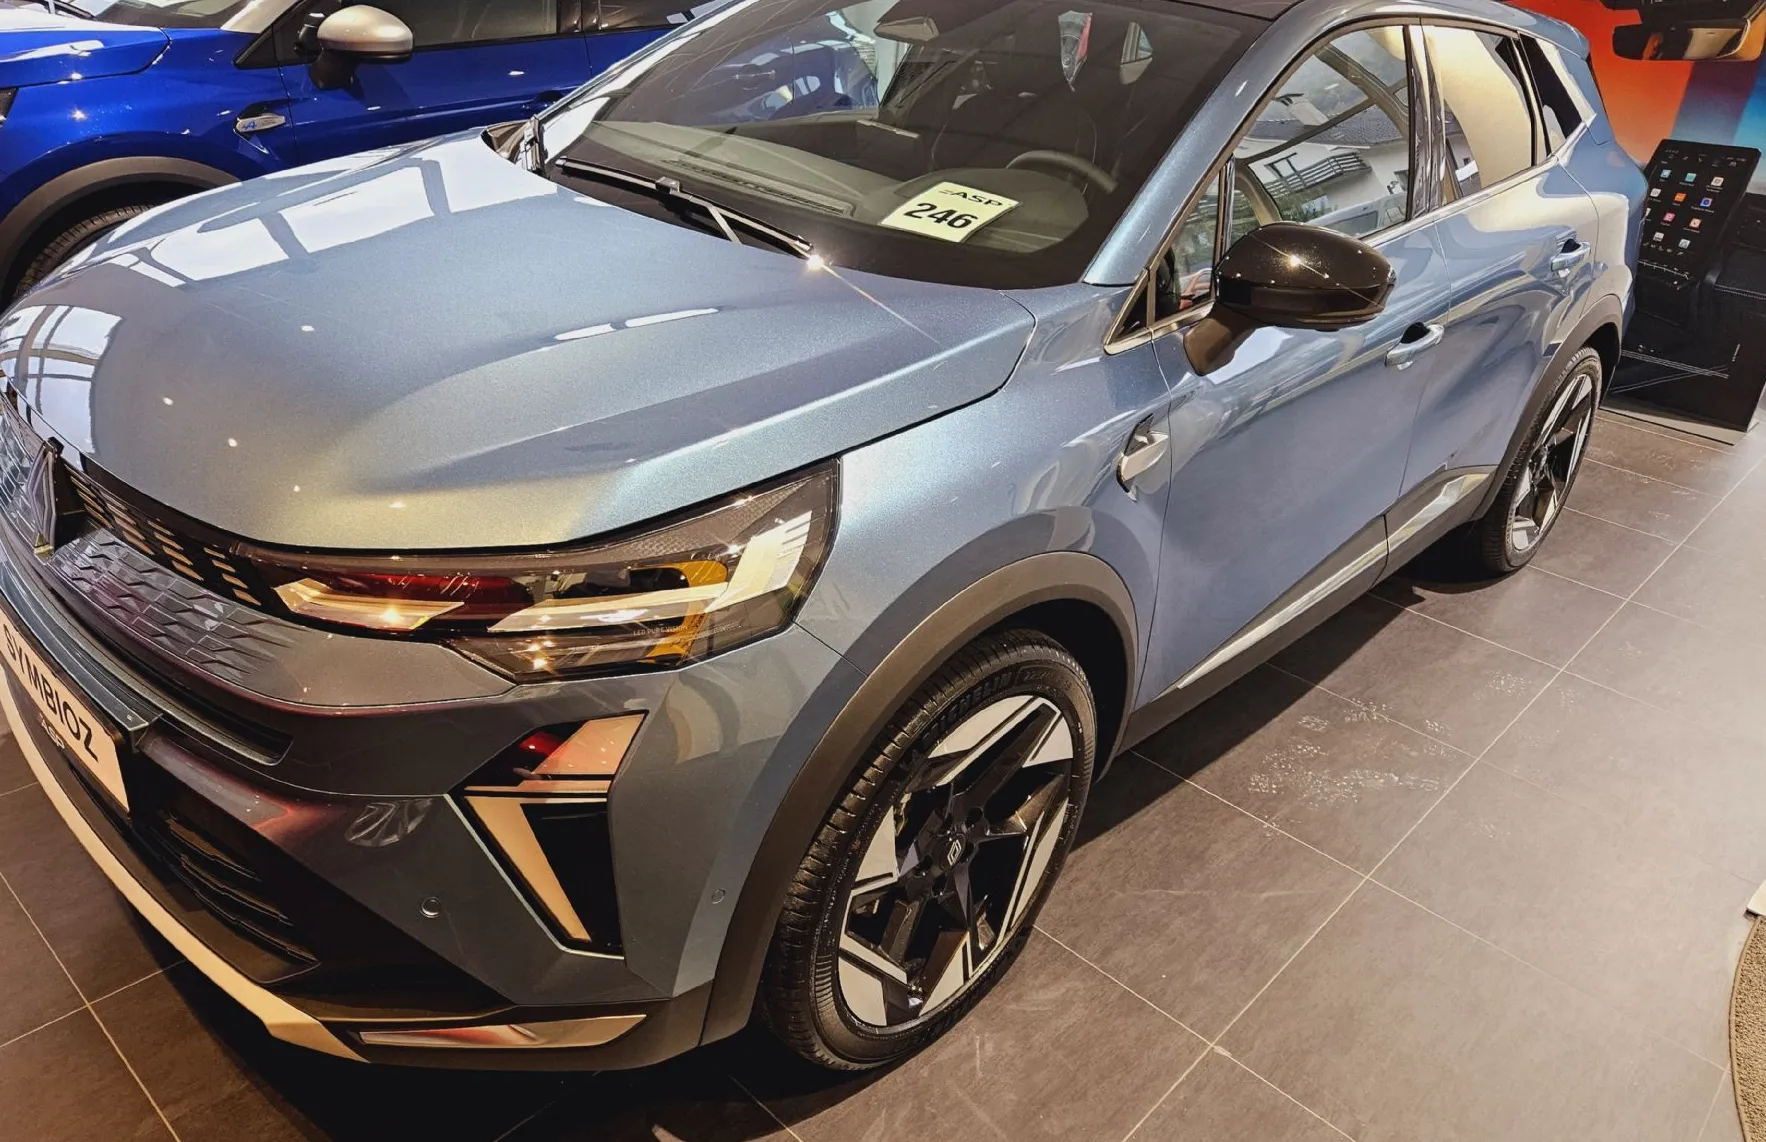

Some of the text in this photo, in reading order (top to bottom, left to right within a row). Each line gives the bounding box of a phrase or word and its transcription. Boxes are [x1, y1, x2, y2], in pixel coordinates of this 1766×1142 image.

[950, 191, 1003, 206] ASP
[904, 202, 978, 229] 246
[633, 628, 646, 637] LED
[647, 625, 664, 635] PURE
[3, 623, 98, 762] SYMBIOZ
